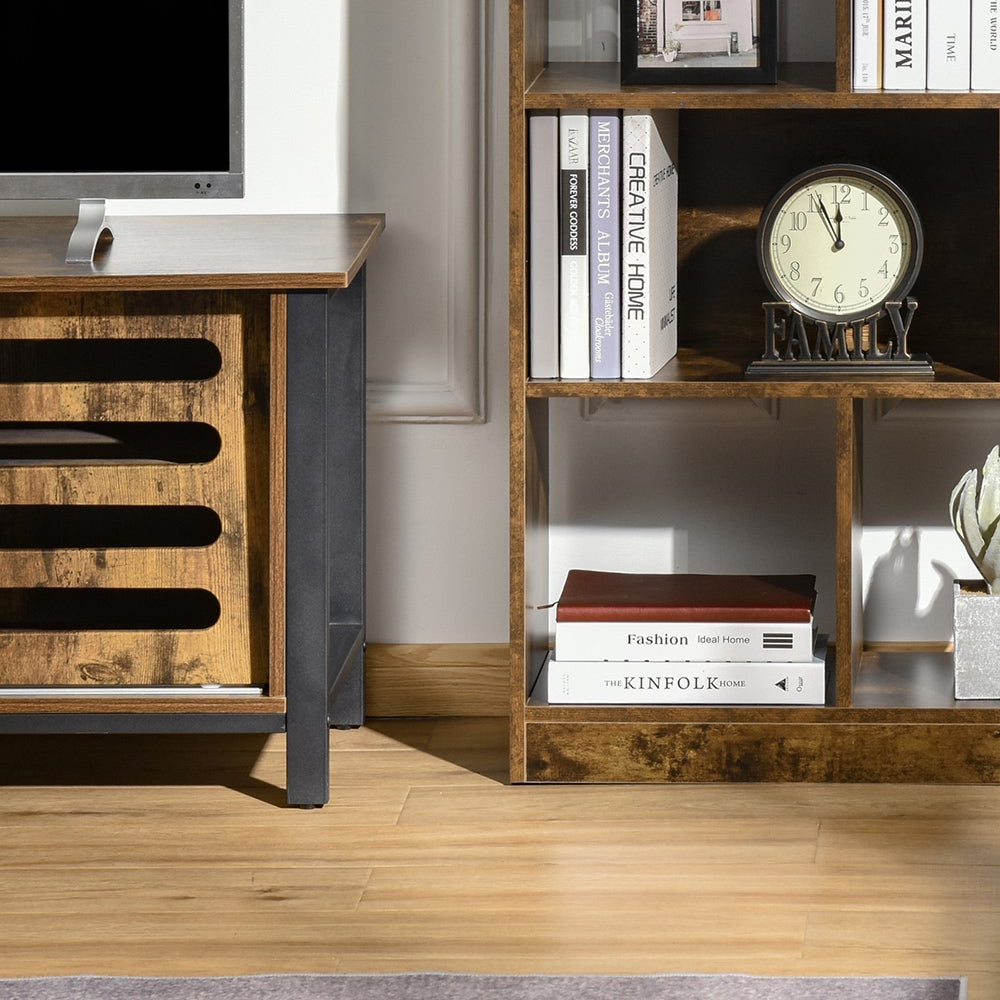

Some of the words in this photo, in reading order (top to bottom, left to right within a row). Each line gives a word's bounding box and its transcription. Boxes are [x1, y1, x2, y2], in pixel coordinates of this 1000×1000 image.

[946, 33, 956, 62] TIME
[598, 122, 611, 219] MERCHANTS
[569, 174, 578, 209] FOREVER
[830, 184, 852, 204] 12
[861, 191, 870, 211] 1
[628, 152, 646, 254] CREATIVE
[790, 211, 808, 232] 10
[878, 207, 890, 226] 2
[569, 212, 578, 251] GODDESS
[781, 234, 792, 254] 9
[888, 234, 900, 254] 3
[598, 230, 610, 285] ALBUM
[790, 261, 800, 281] 8
[878, 260, 889, 280] 4
[627, 264, 645, 320] HOME
[811, 278, 822, 297] 7
[834, 284, 844, 304] 6
[859, 278, 870, 298] 5
[604, 292, 614, 336] Gästebäder
[594, 317, 604, 362] Cloakrooms
[762, 301, 918, 362] FAMILY
[626, 634, 689, 646] Fashion
[697, 635, 720, 644] Ideal
[722, 635, 750, 644] Home
[624, 676, 719, 690] KINFOLK
